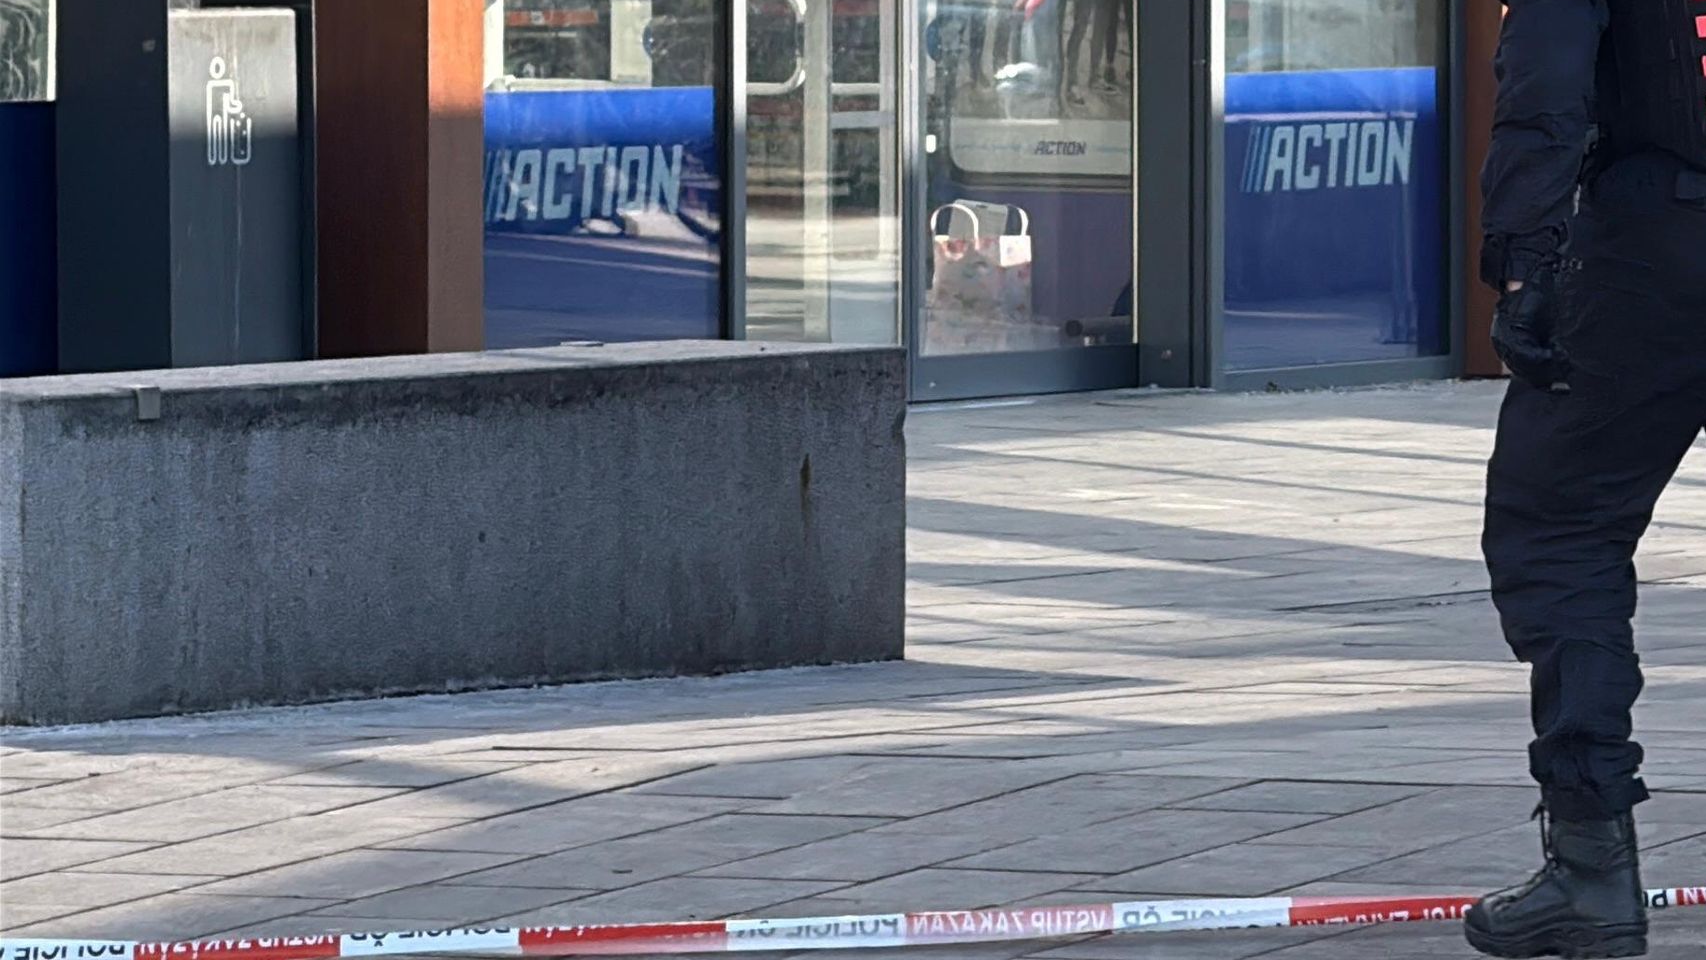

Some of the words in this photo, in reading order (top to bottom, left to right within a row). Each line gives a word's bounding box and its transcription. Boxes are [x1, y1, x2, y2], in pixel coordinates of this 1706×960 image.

[506, 143, 684, 220] ACTION
[1034, 140, 1088, 155] ACTION
[1264, 118, 1414, 190] ACTION
